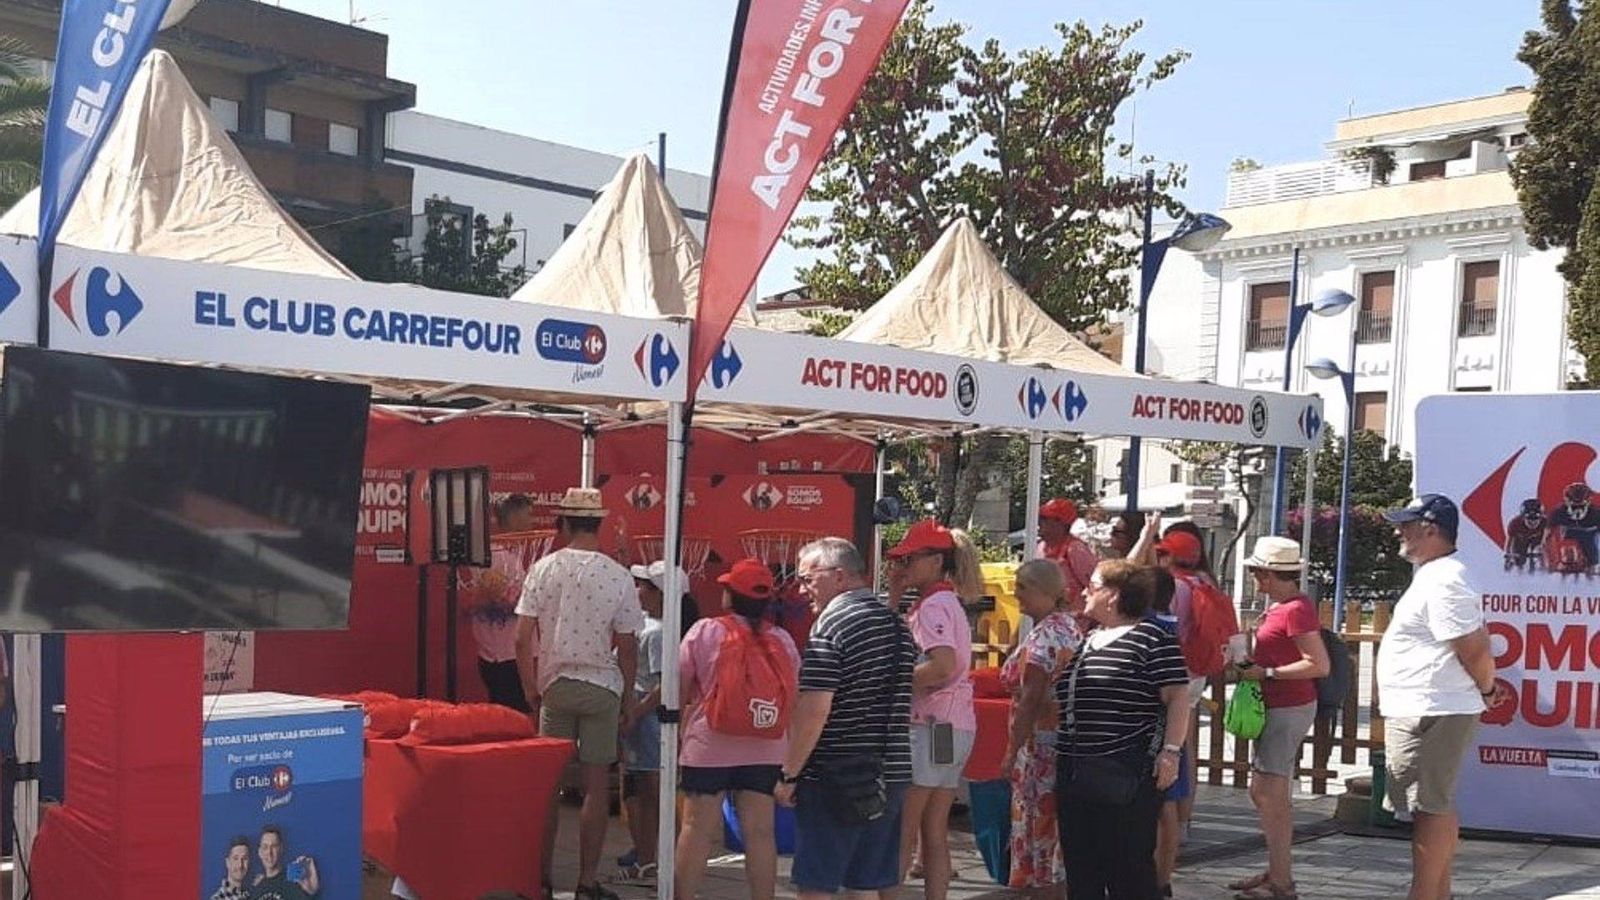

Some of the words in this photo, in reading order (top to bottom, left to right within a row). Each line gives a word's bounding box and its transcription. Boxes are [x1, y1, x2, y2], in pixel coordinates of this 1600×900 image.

[758, 20, 812, 115] ACTIVIDADES
[66, 80, 112, 138] EL
[751, 108, 812, 211] ACT
[791, 8, 864, 108] FOR
[194, 290, 236, 328] EL
[243, 296, 336, 337] CLUB
[343, 306, 521, 355] CARREFOUR
[542, 331, 552, 348] El
[556, 333, 582, 350] Club
[801, 357, 847, 389] ACT
[850, 362, 892, 394] FOR
[895, 367, 948, 399] FOOD
[1132, 394, 1167, 419] ACT
[1169, 397, 1201, 423] FOR
[1203, 400, 1245, 425] FOOD
[1482, 594, 1521, 614] FOUR
[1526, 594, 1558, 614] CON
[1562, 597, 1582, 615] LA
[1483, 749, 1498, 762] LA
[1498, 750, 1542, 765] VUELTA
[235, 776, 245, 790] El
[248, 774, 271, 788] Club
